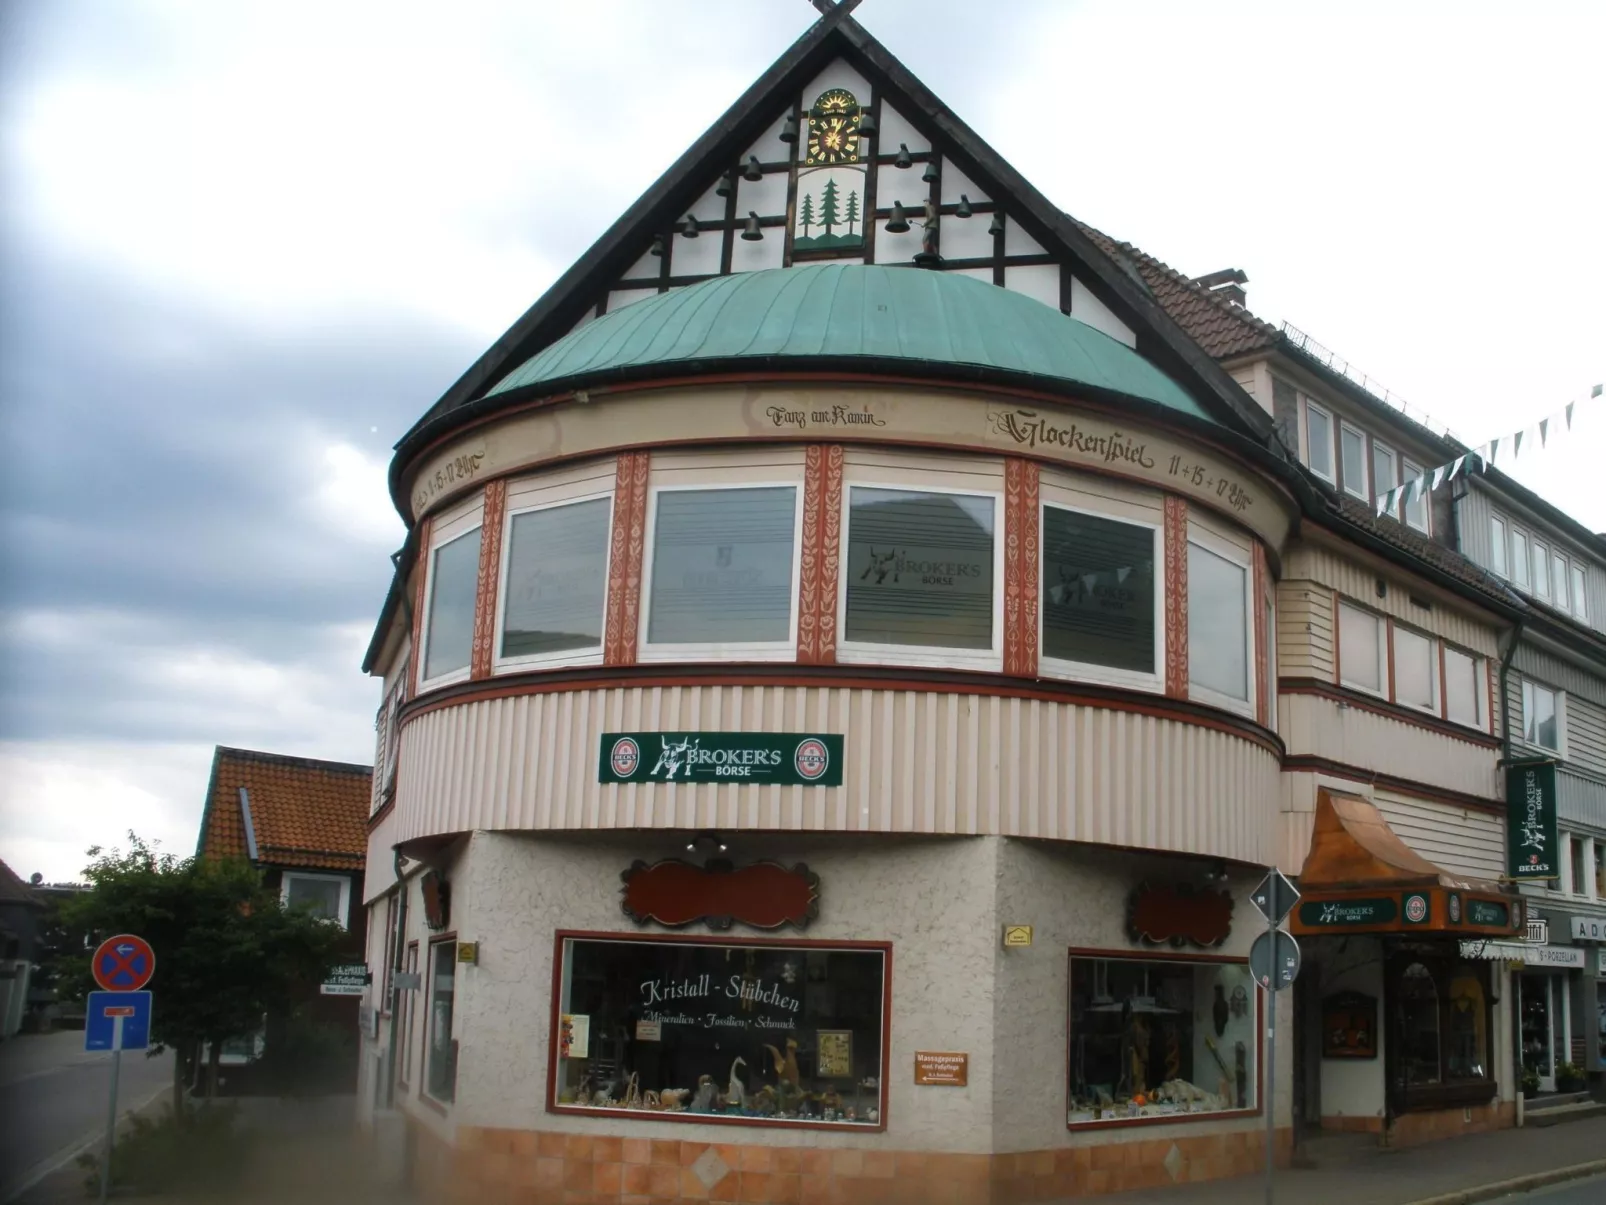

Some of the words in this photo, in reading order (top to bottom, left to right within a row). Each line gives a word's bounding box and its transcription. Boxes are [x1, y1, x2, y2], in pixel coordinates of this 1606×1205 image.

[988, 410, 1155, 468] Glockenspiel
[686, 749, 782, 765] BROKER'S
[715, 765, 751, 776] BÖRSE
[1518, 864, 1550, 872] BECK'S
[640, 974, 710, 1006] Kristall
[725, 975, 800, 1012] Stübchen
[641, 1010, 694, 1025] Mineralien
[704, 1013, 745, 1029] Fossilien
[917, 1054, 965, 1064] Massagepraxis
